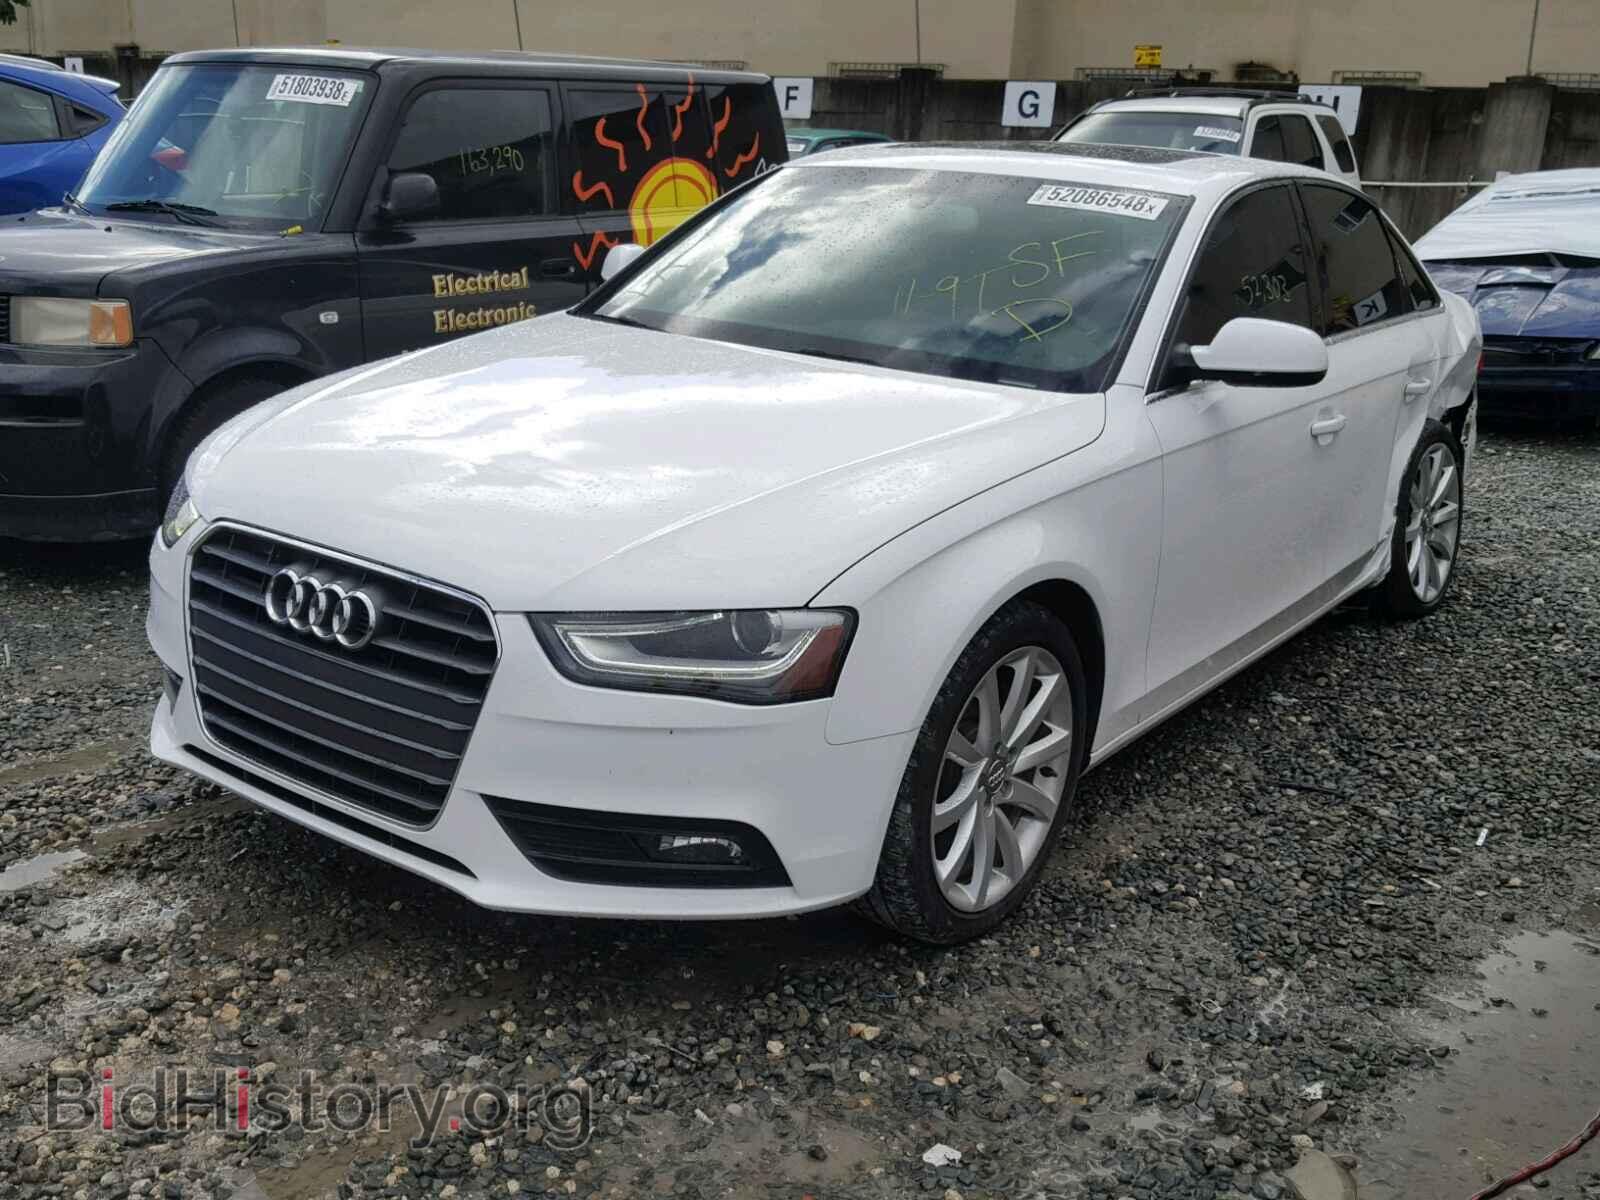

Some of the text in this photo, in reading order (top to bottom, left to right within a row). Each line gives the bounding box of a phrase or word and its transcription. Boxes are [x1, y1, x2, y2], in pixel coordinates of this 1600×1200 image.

[784, 86, 799, 111] F
[1018, 90, 1040, 119] G
[431, 265, 529, 298] Electrical
[432, 301, 537, 333] Electronic
